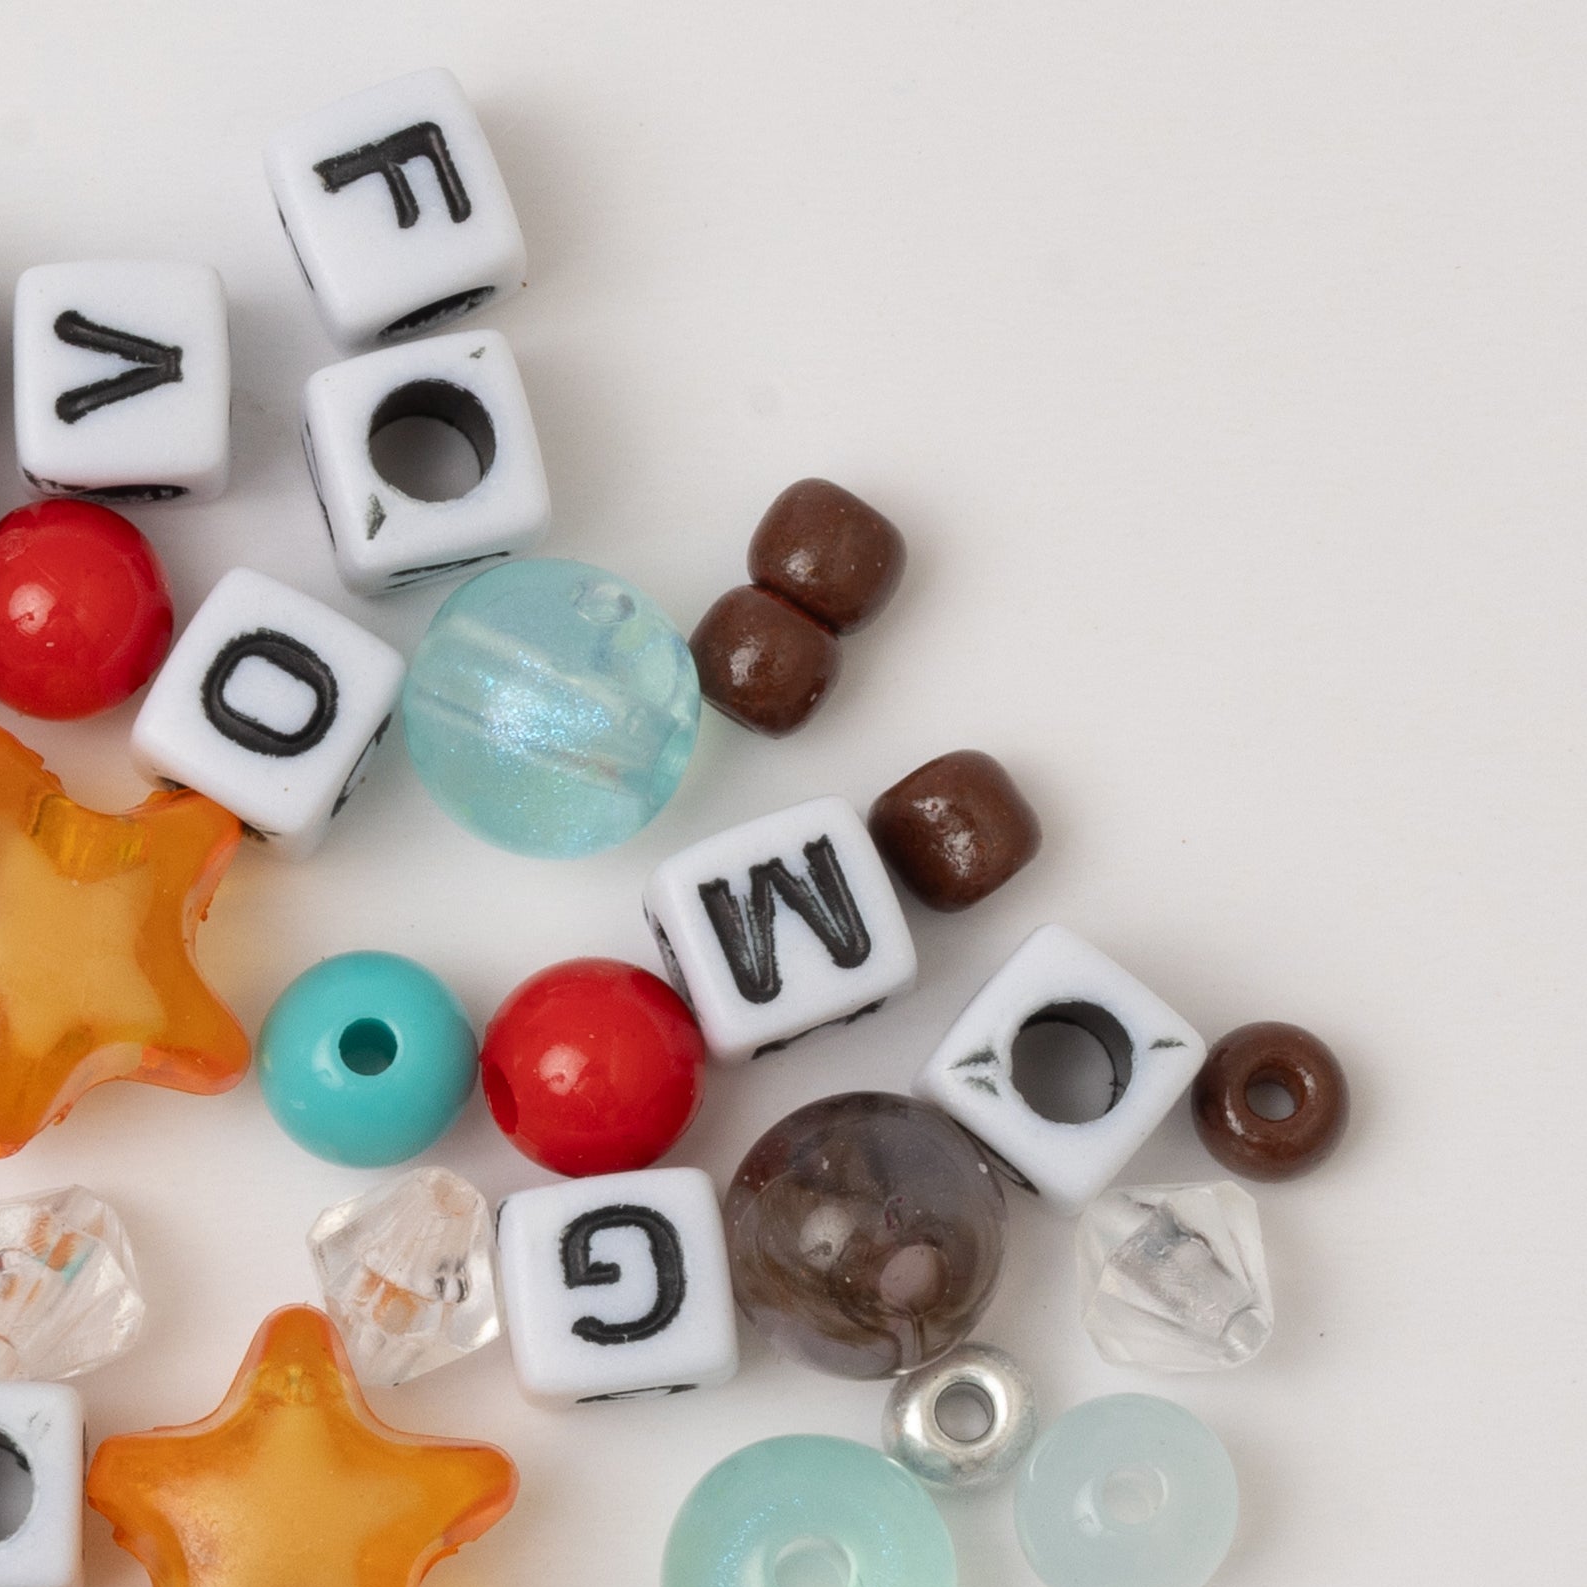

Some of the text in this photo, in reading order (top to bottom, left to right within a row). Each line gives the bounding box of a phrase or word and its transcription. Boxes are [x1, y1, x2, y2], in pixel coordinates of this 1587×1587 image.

[312, 120, 473, 230] F
[52, 309, 184, 426] V
[199, 626, 340, 760] O
[558, 1202, 688, 1347] G
